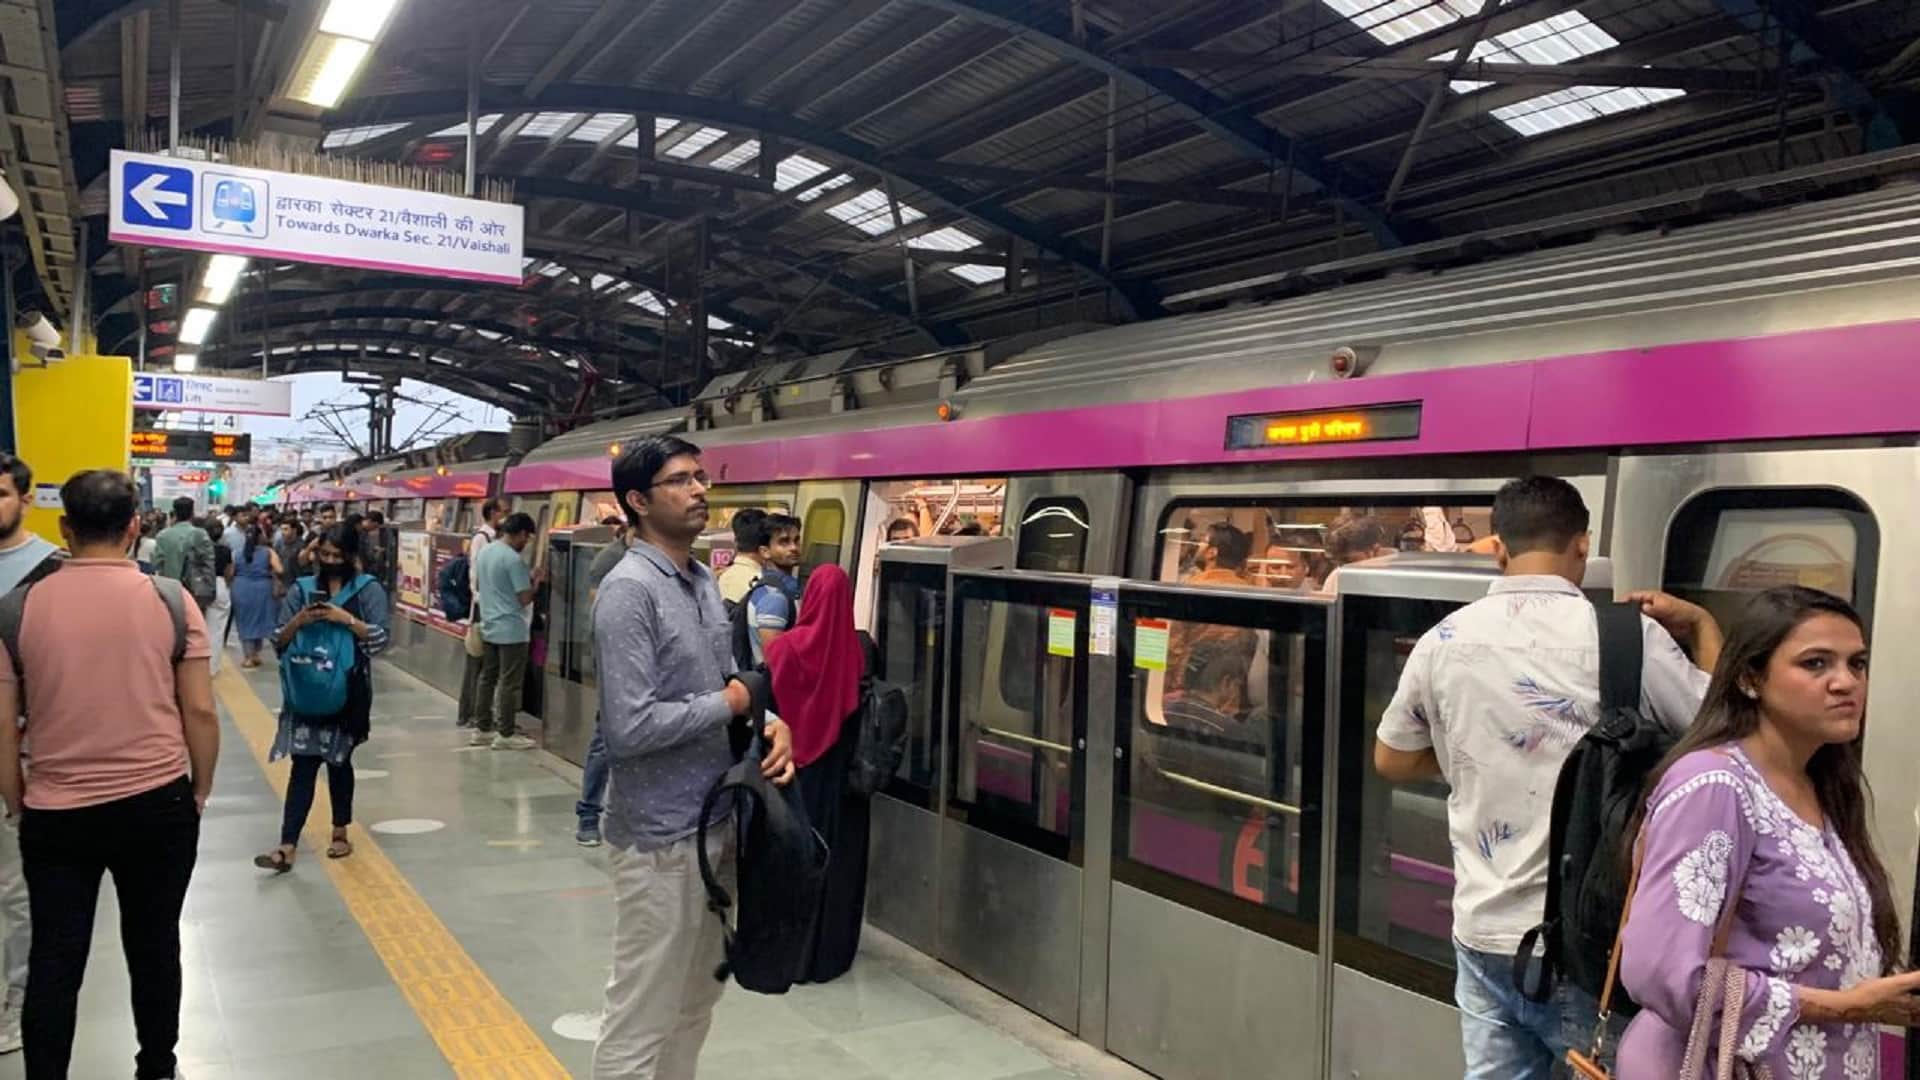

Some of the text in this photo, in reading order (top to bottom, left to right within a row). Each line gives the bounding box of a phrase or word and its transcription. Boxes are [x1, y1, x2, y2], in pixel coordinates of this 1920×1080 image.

[275, 196, 322, 213] द्वारका
[329, 199, 376, 220] सेक्टर
[454, 215, 474, 232] की
[480, 219, 505, 236] ओर
[275, 214, 511, 254] Towards Dwarka Sec. 21/Vaishali
[223, 415, 235, 428] 4
